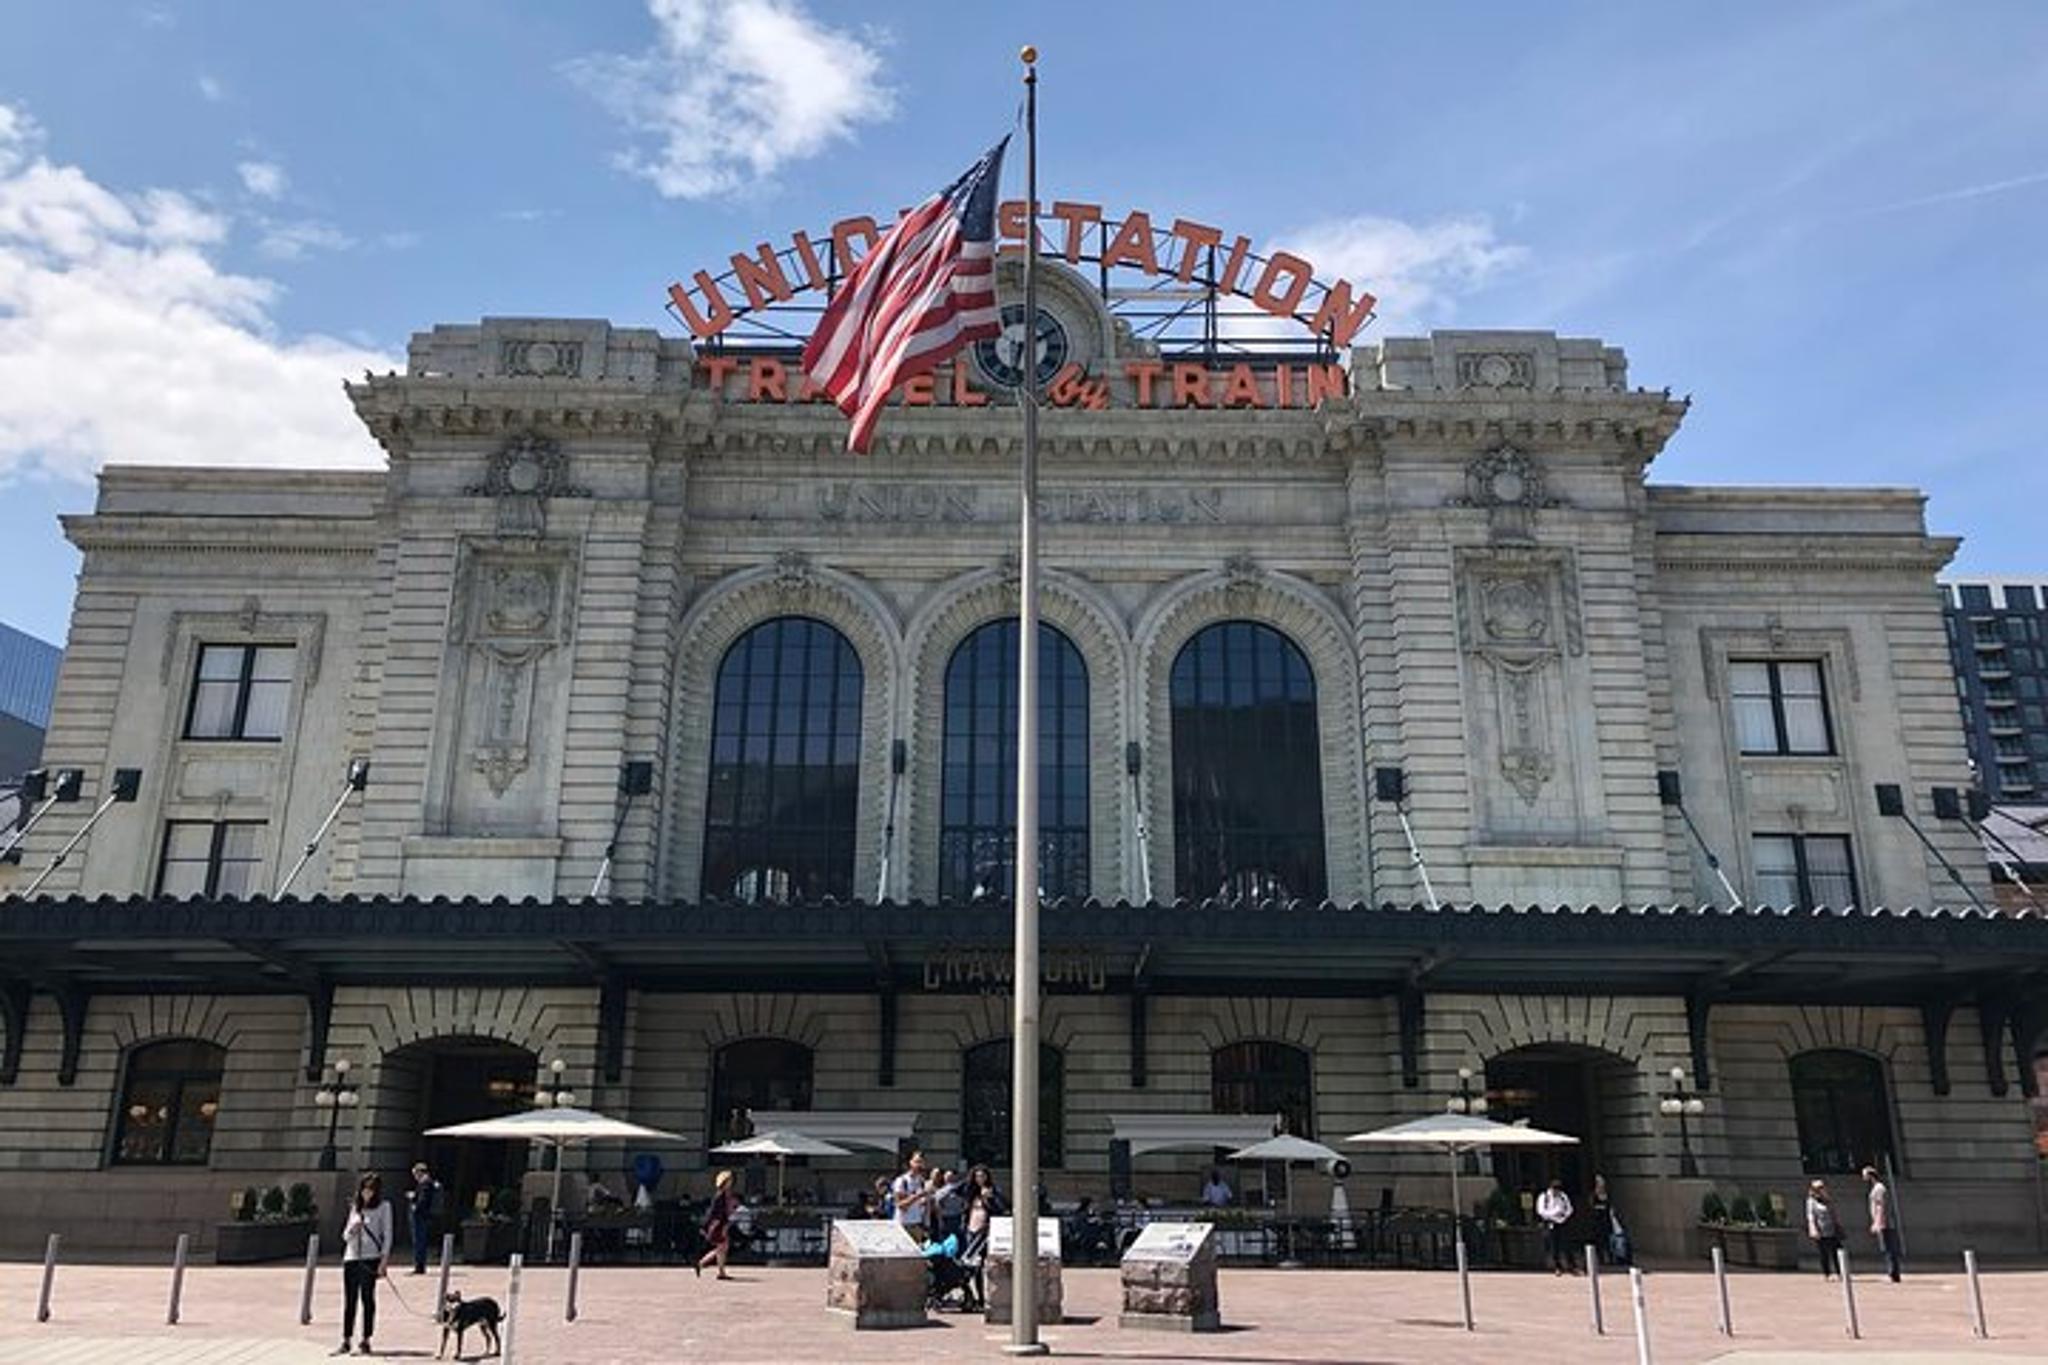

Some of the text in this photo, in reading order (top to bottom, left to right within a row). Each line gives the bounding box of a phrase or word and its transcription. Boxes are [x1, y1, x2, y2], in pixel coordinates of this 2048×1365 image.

[667, 201, 1377, 347] UNIO STATION
[699, 354, 1347, 411] TREL by TRAIN
[815, 483, 979, 521] UNION
[923, 950, 1105, 990] CRAWORD
